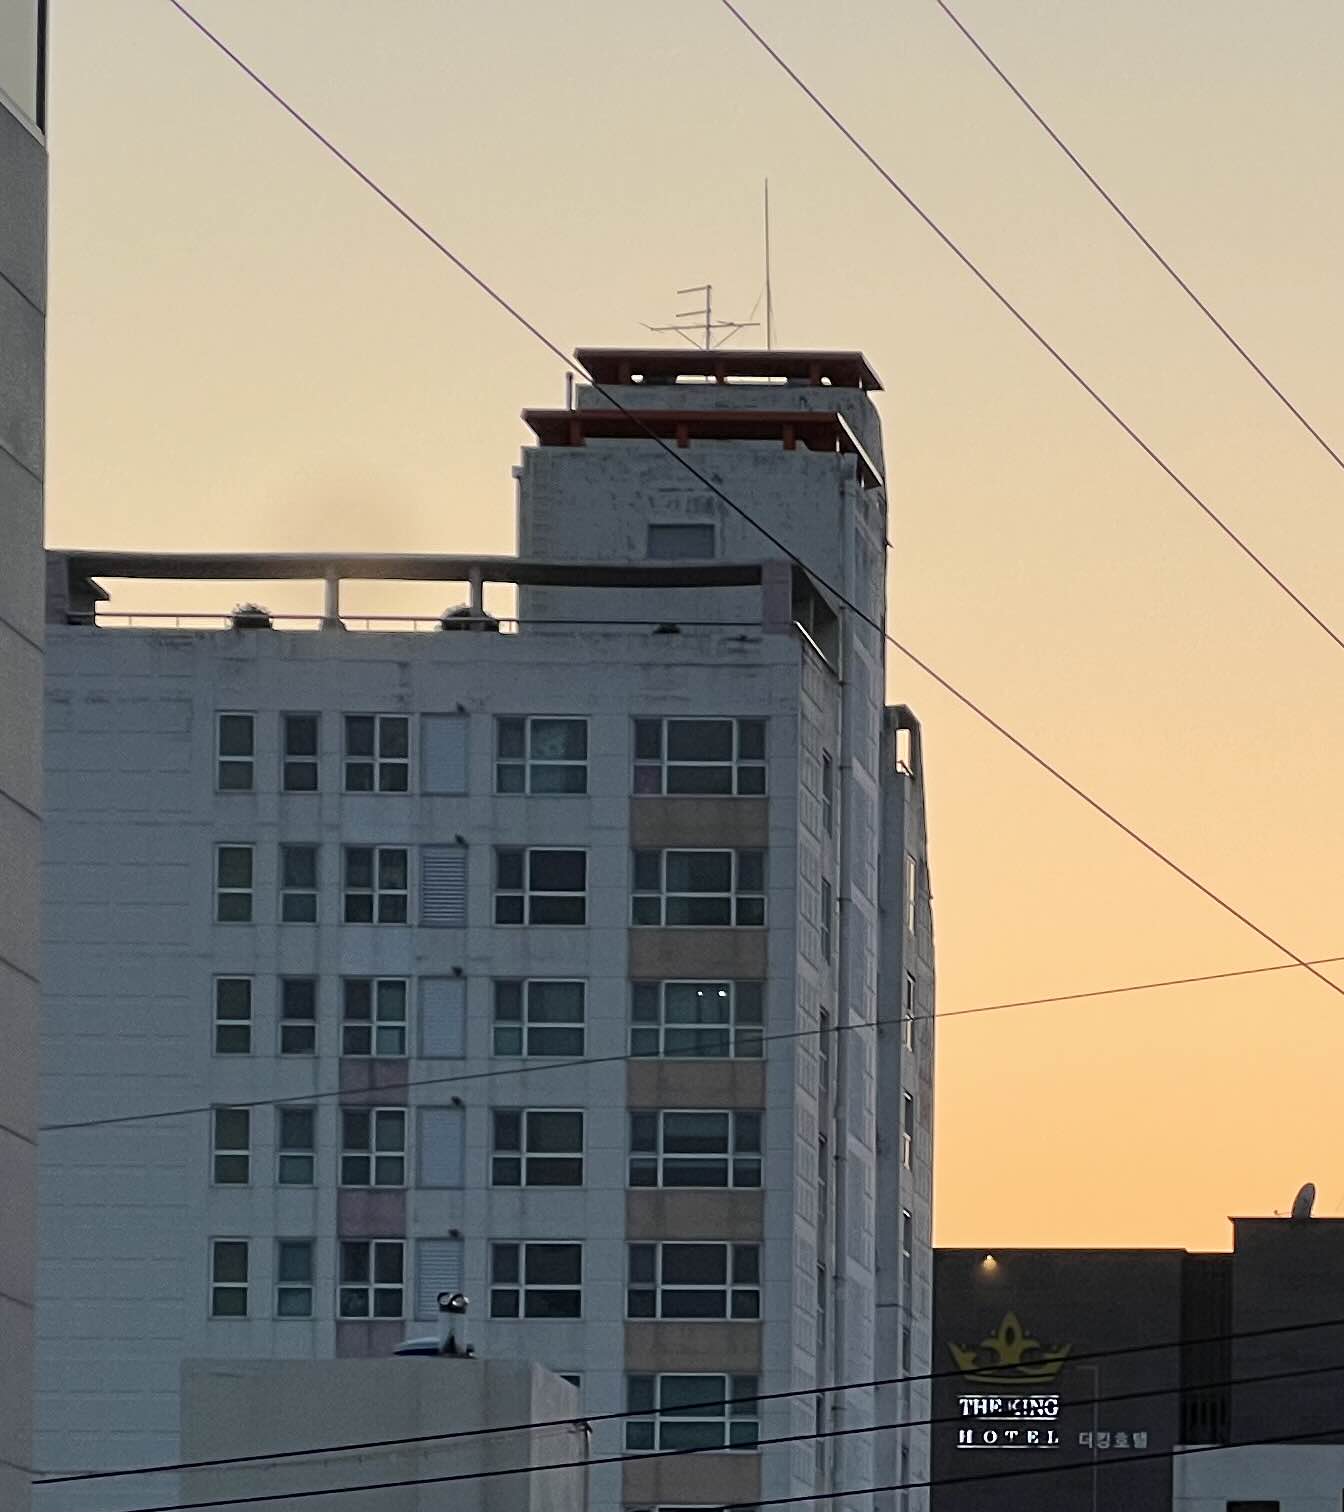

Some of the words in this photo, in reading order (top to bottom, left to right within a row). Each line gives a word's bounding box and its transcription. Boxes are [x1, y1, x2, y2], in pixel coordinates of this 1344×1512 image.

[958, 1397, 1002, 1416] THE
[1007, 1397, 1059, 1416] KING
[958, 1429, 1059, 1444] HOTEL
[1079, 1431, 1148, 1449] 더킹호텔
